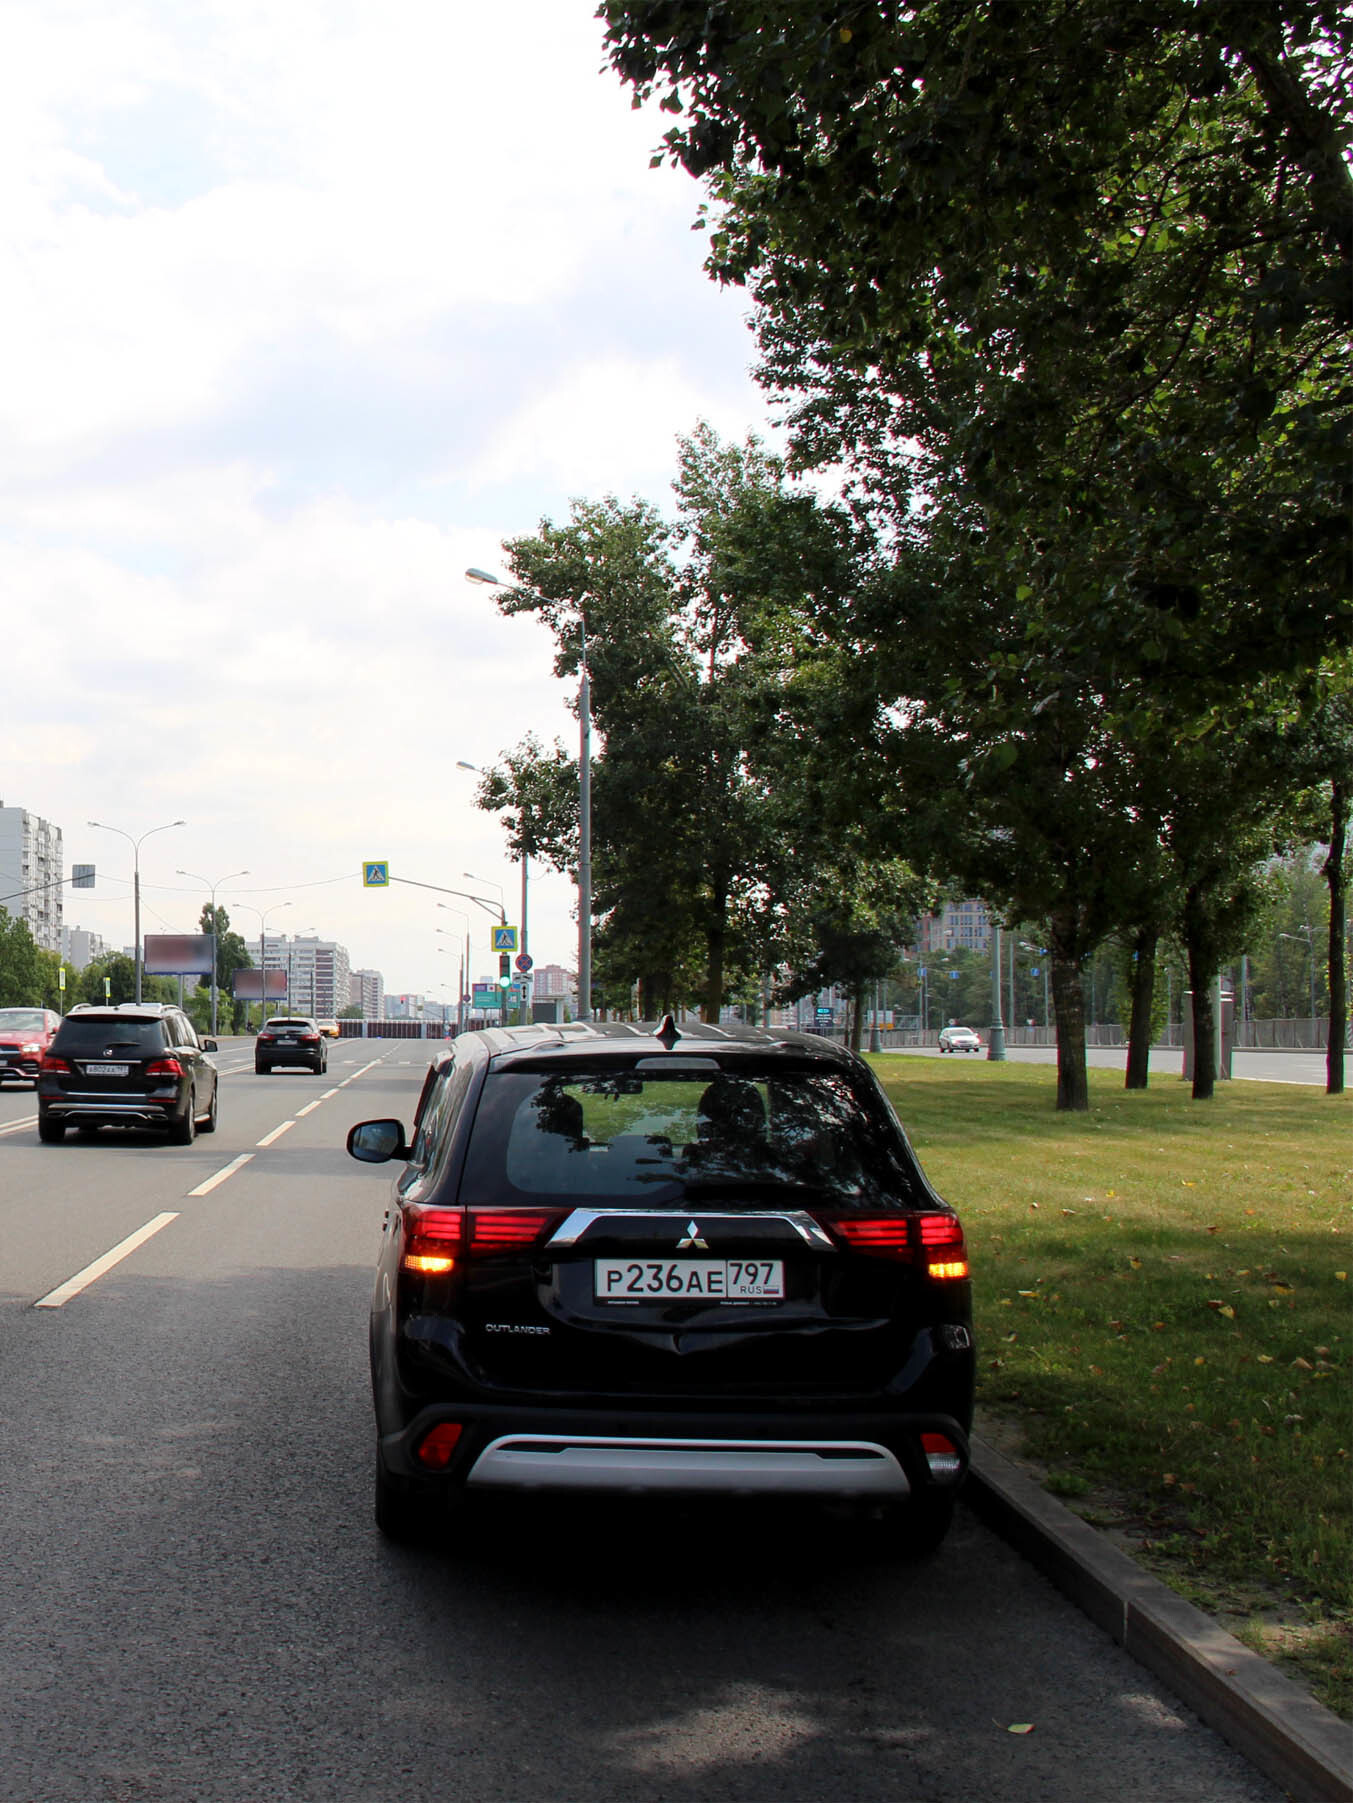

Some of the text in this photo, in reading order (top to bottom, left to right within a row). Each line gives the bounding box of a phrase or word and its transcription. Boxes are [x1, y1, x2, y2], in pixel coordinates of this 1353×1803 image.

[607, 1262, 774, 1293] Р236АЕ 797
[740, 1285, 762, 1294] RUS
[485, 1323, 550, 1335] OUTLANDER
